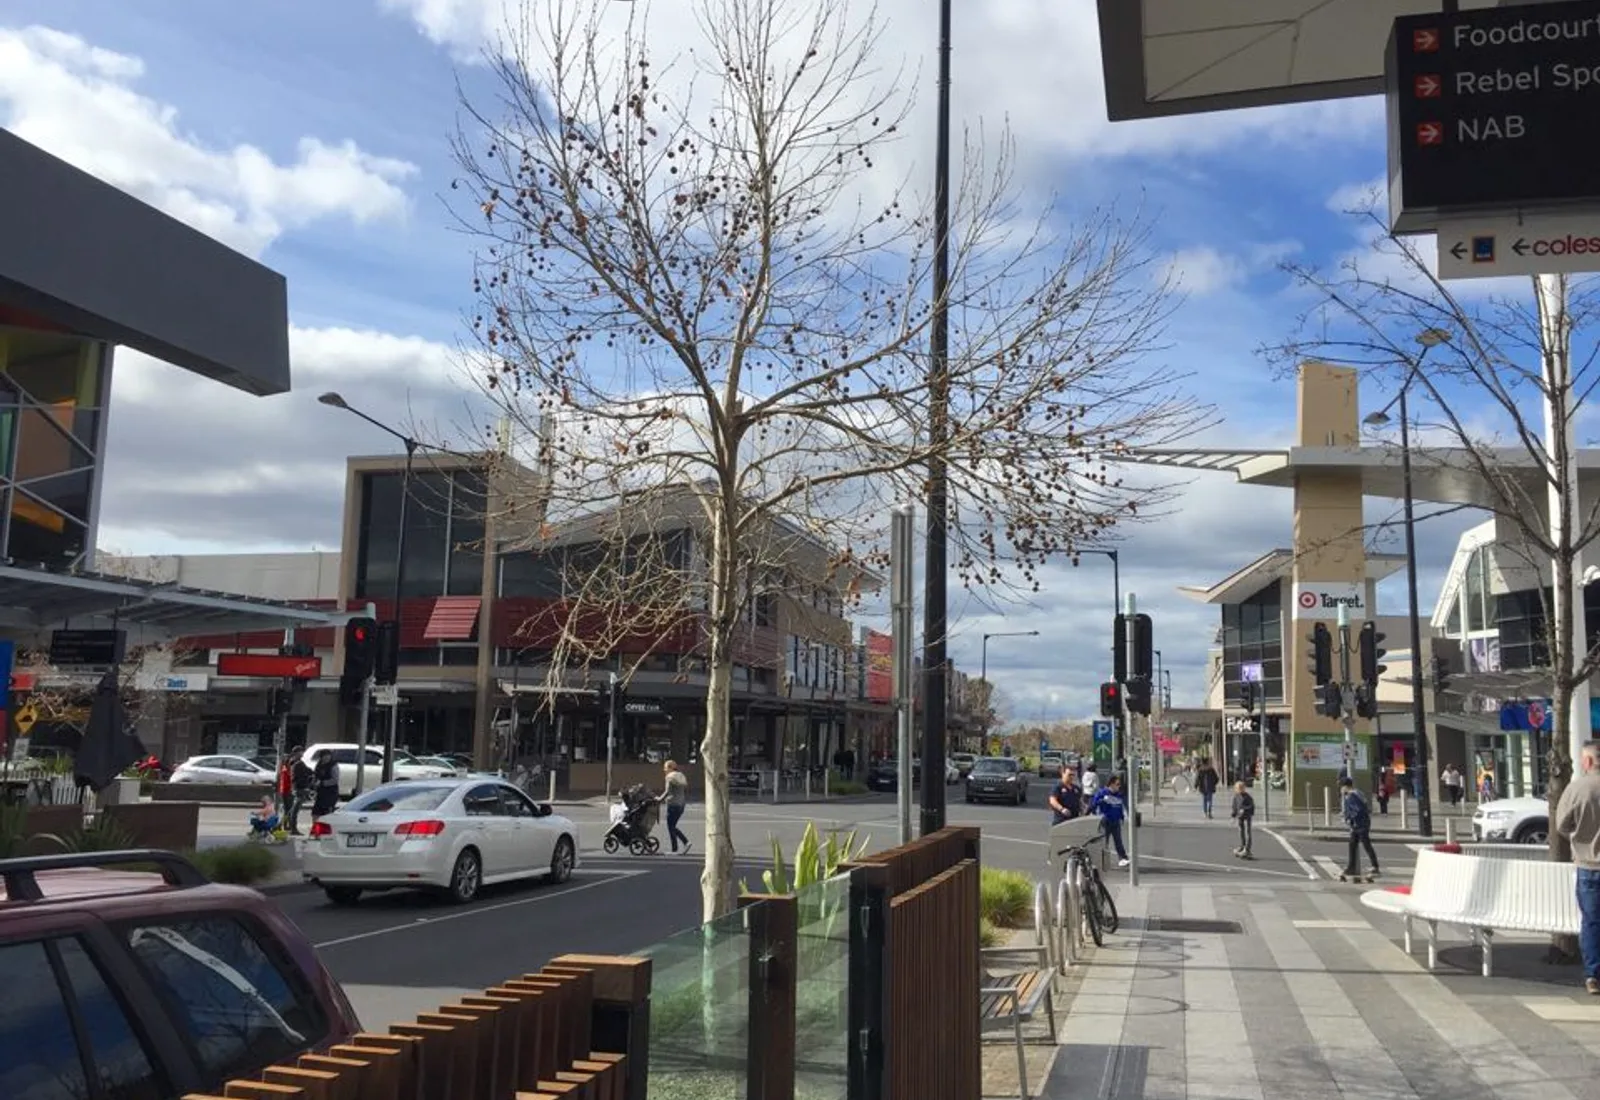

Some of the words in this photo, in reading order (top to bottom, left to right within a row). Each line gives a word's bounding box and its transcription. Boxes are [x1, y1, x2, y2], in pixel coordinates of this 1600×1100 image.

[1456, 64, 1540, 94] Rebel
[1458, 115, 1525, 142] NAB
[1533, 234, 1600, 256] coles
[1097, 723, 1110, 738] P
